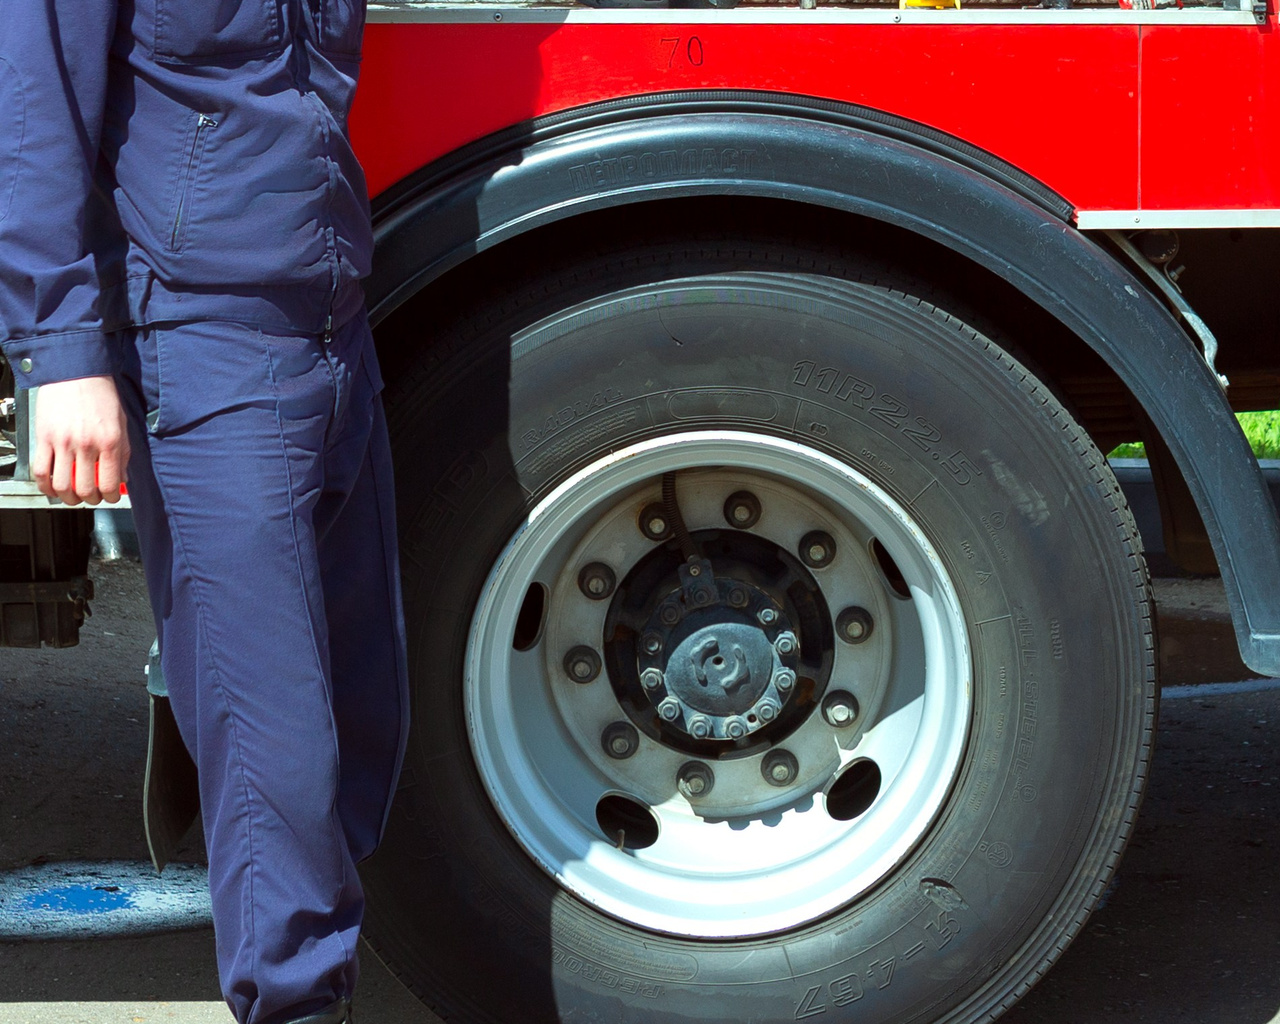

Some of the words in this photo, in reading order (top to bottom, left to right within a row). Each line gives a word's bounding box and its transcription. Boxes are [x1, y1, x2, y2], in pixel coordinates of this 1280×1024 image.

[660, 36, 704, 68] 70
[568, 148, 757, 192] ПЕТРОПЛАСТ
[521, 387, 622, 450] RADIAL
[792, 359, 982, 487] 11R22.5
[1013, 680, 1039, 777] STEEL
